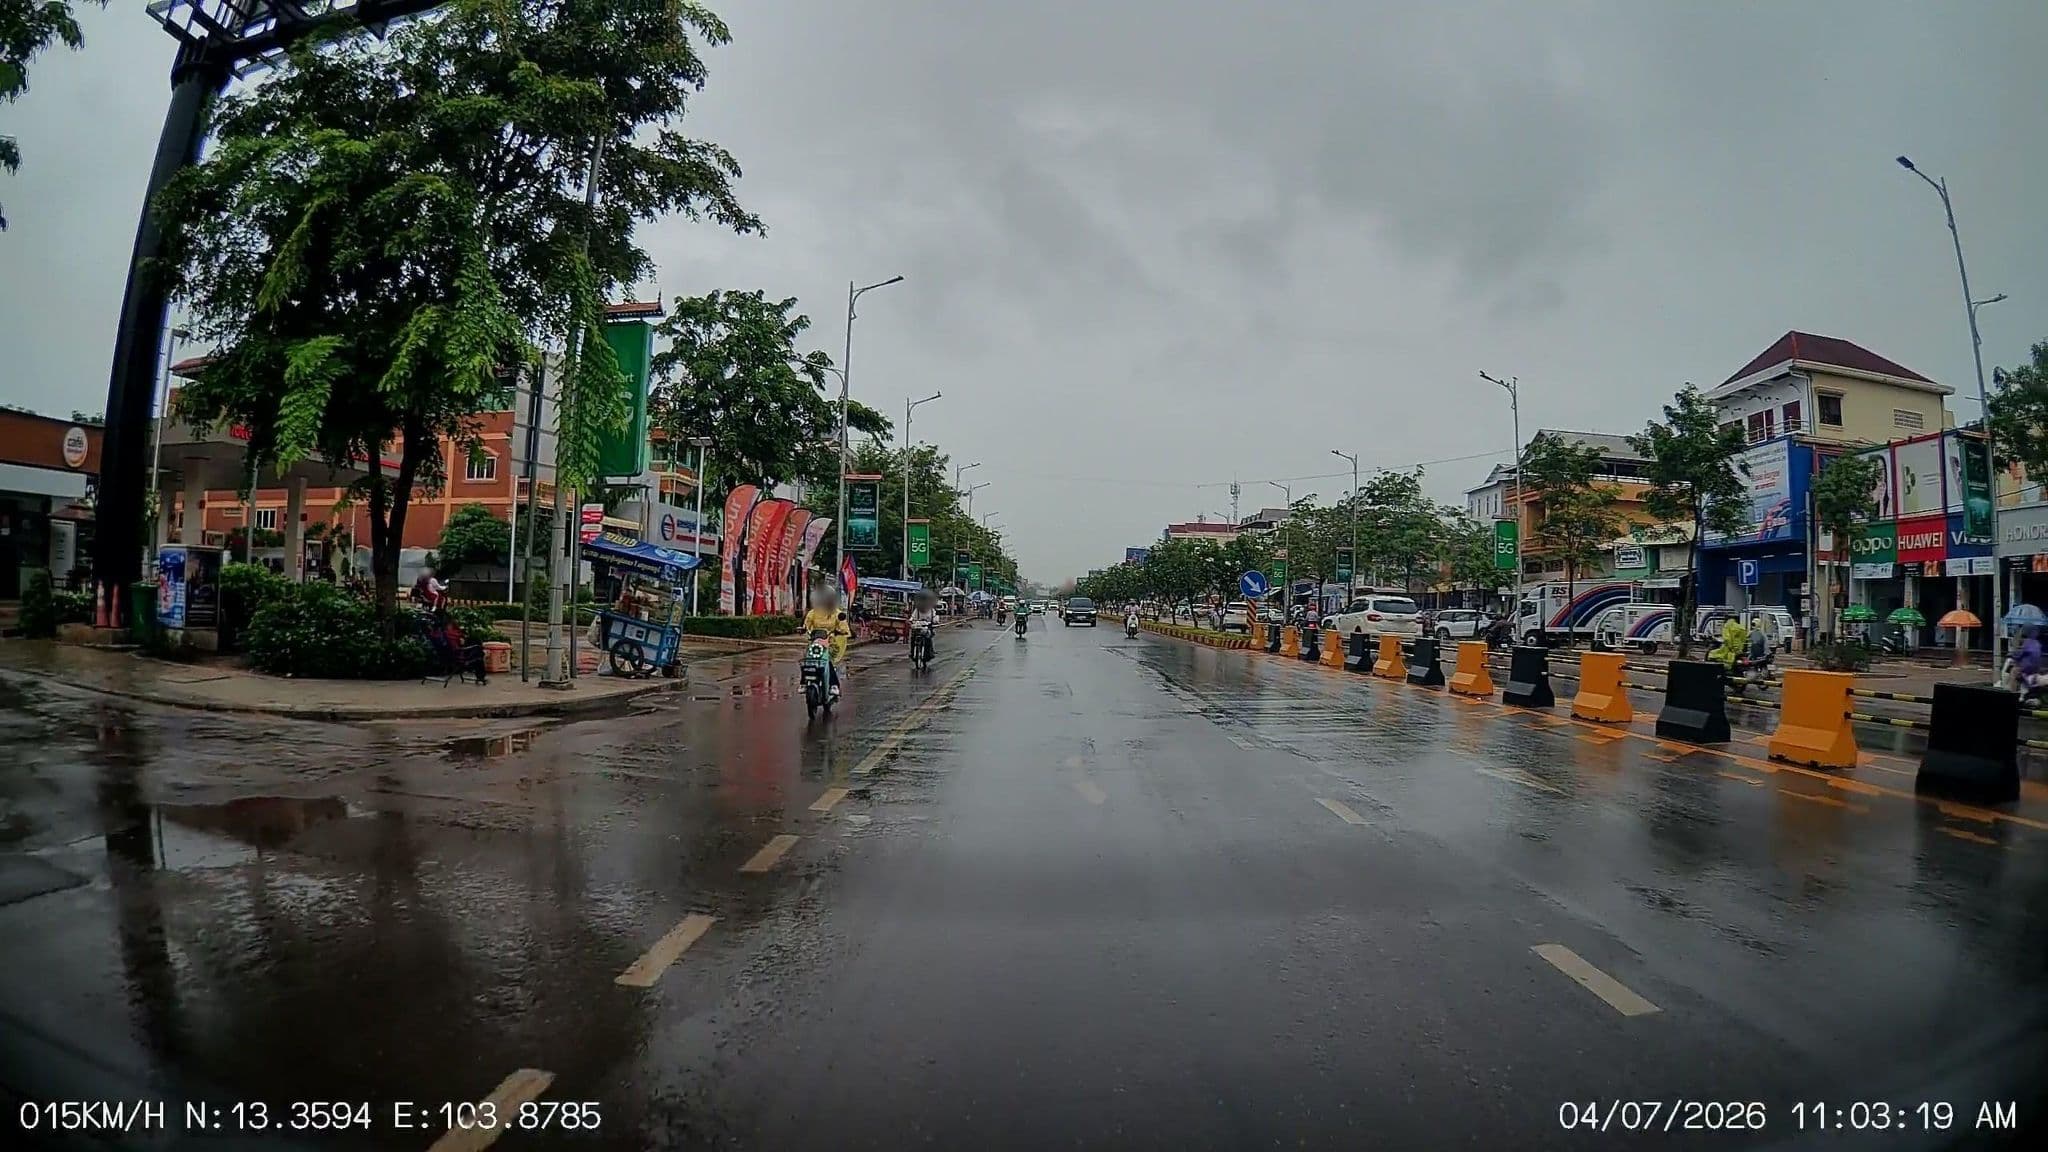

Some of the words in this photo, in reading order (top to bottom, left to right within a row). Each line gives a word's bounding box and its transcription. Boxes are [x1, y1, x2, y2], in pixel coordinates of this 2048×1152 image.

[1898, 531, 1943, 551] HUAWEI
[2006, 523, 2048, 542] HONOR
[911, 542, 927, 553] 5G
[1497, 542, 1514, 554] 5G
[1742, 561, 1754, 584] P
